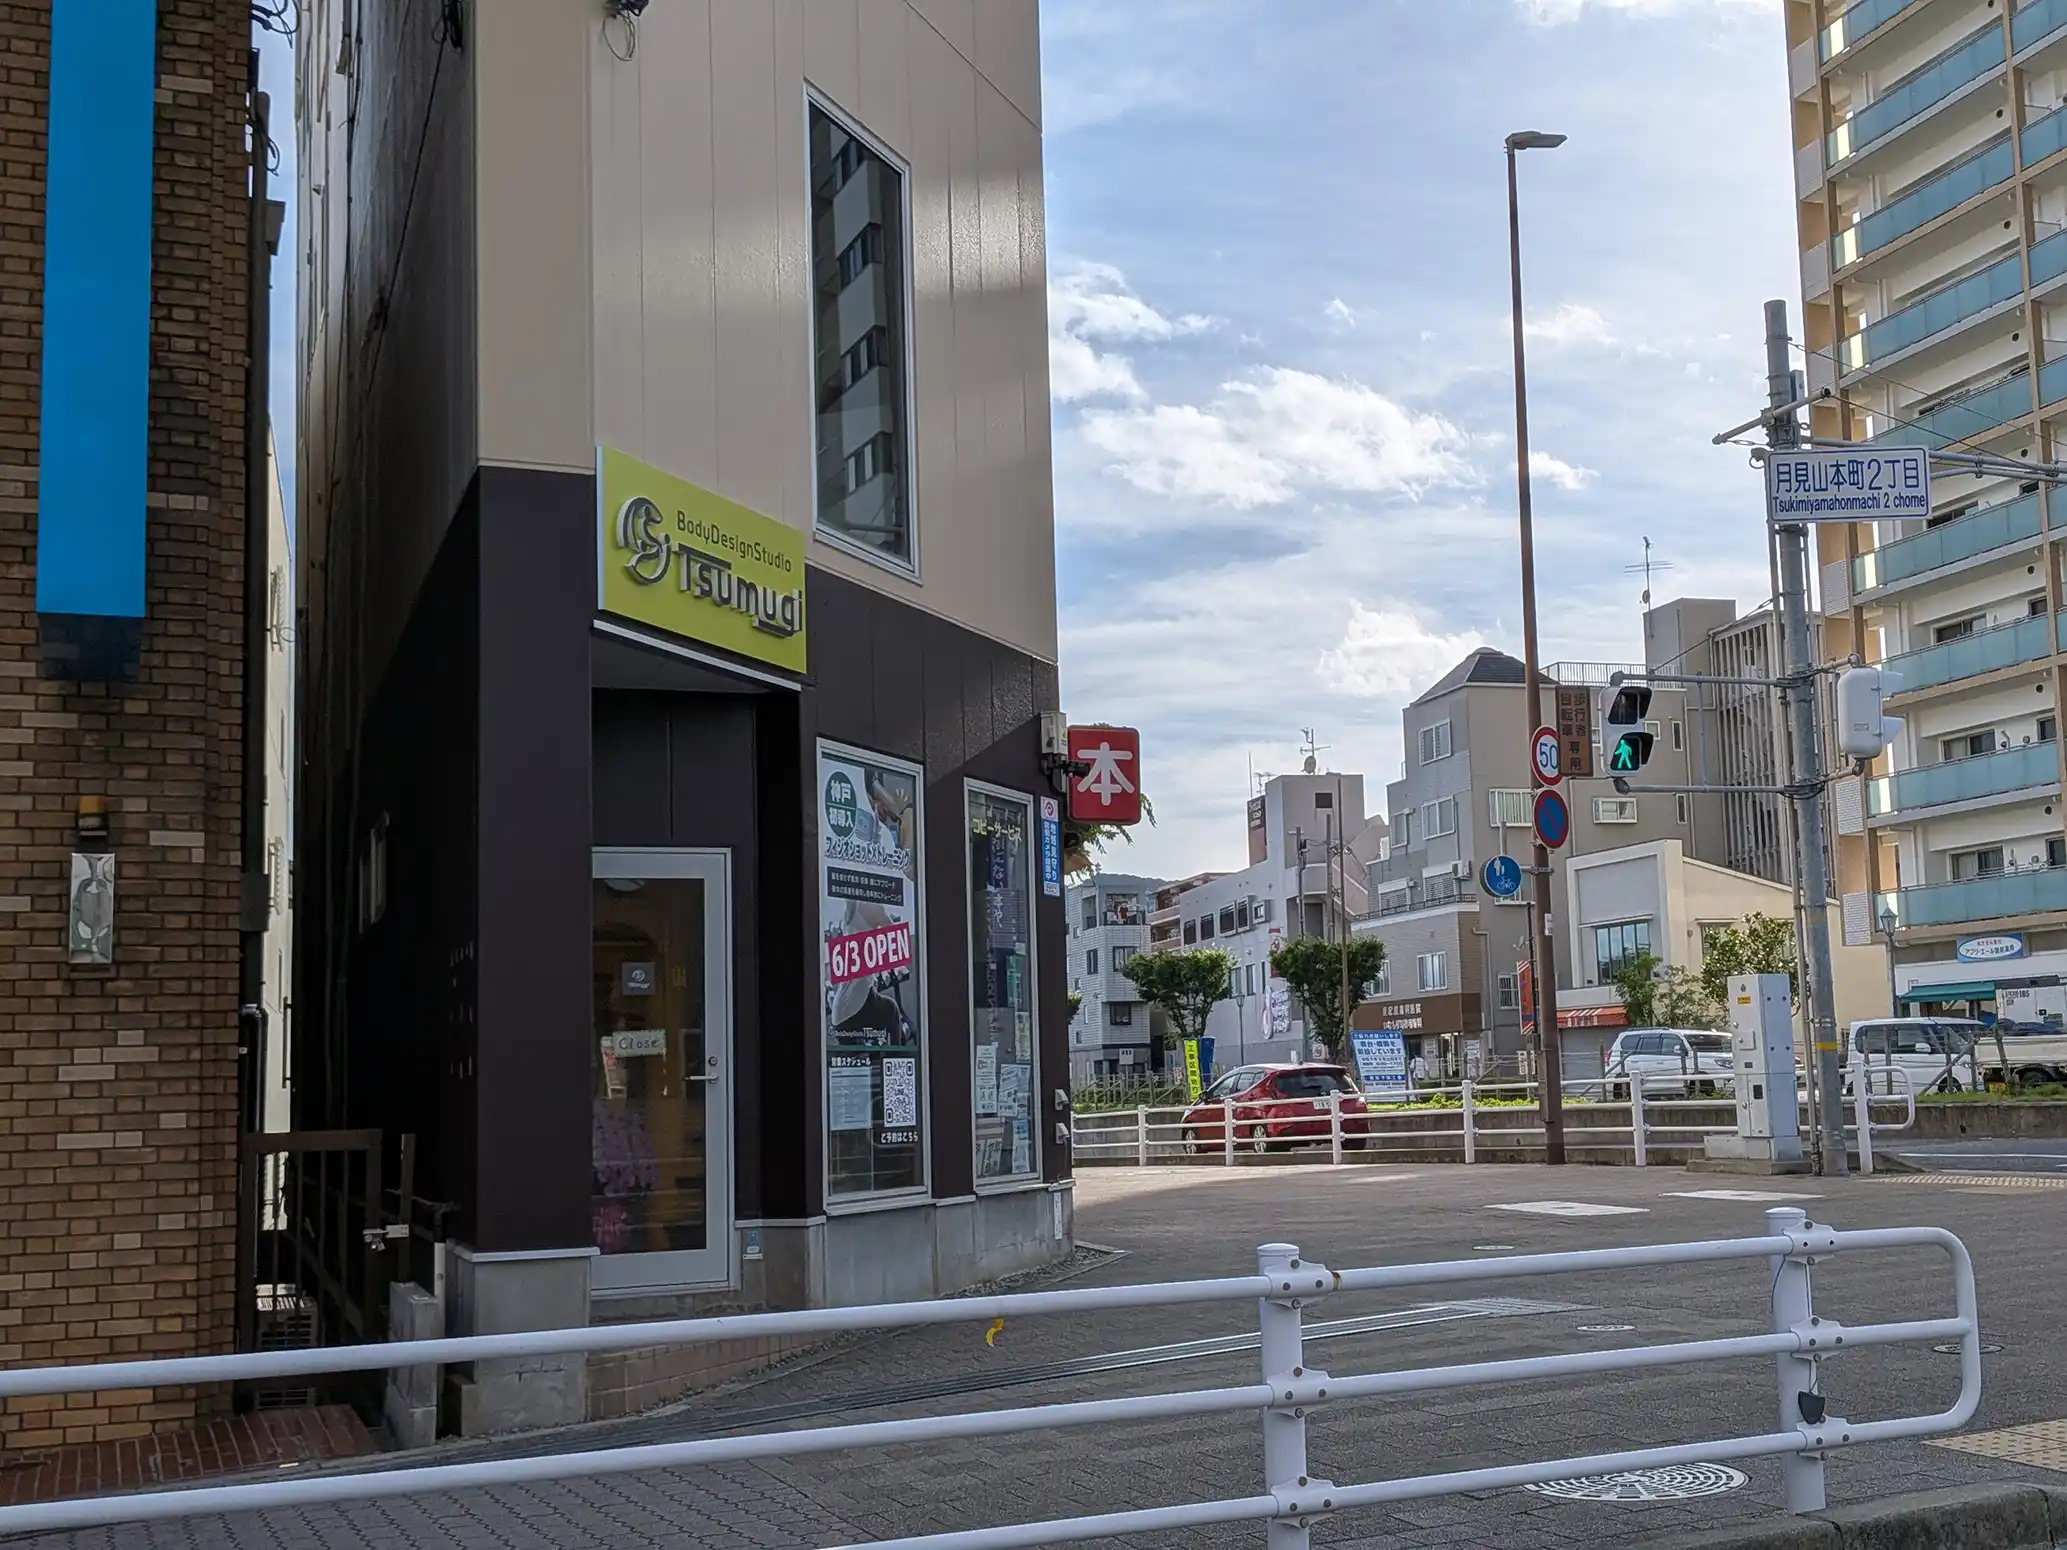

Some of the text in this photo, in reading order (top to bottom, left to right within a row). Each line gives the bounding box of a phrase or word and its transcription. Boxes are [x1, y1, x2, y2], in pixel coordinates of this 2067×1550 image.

[1775, 458, 1920, 494] 月見山本町2丁目
[1773, 491, 1926, 515] Tsukimiyamahonmachi 2 chome
[677, 510, 793, 573] BodyDesignStudio
[673, 542, 803, 638] Tsumugi
[1539, 742, 1558, 770] 50
[1077, 741, 1135, 806] 本
[830, 779, 852, 803] 神戸
[972, 818, 1022, 842] コピーサービス
[832, 928, 910, 977] 6/3 OPEN
[618, 1037, 661, 1050] Close
